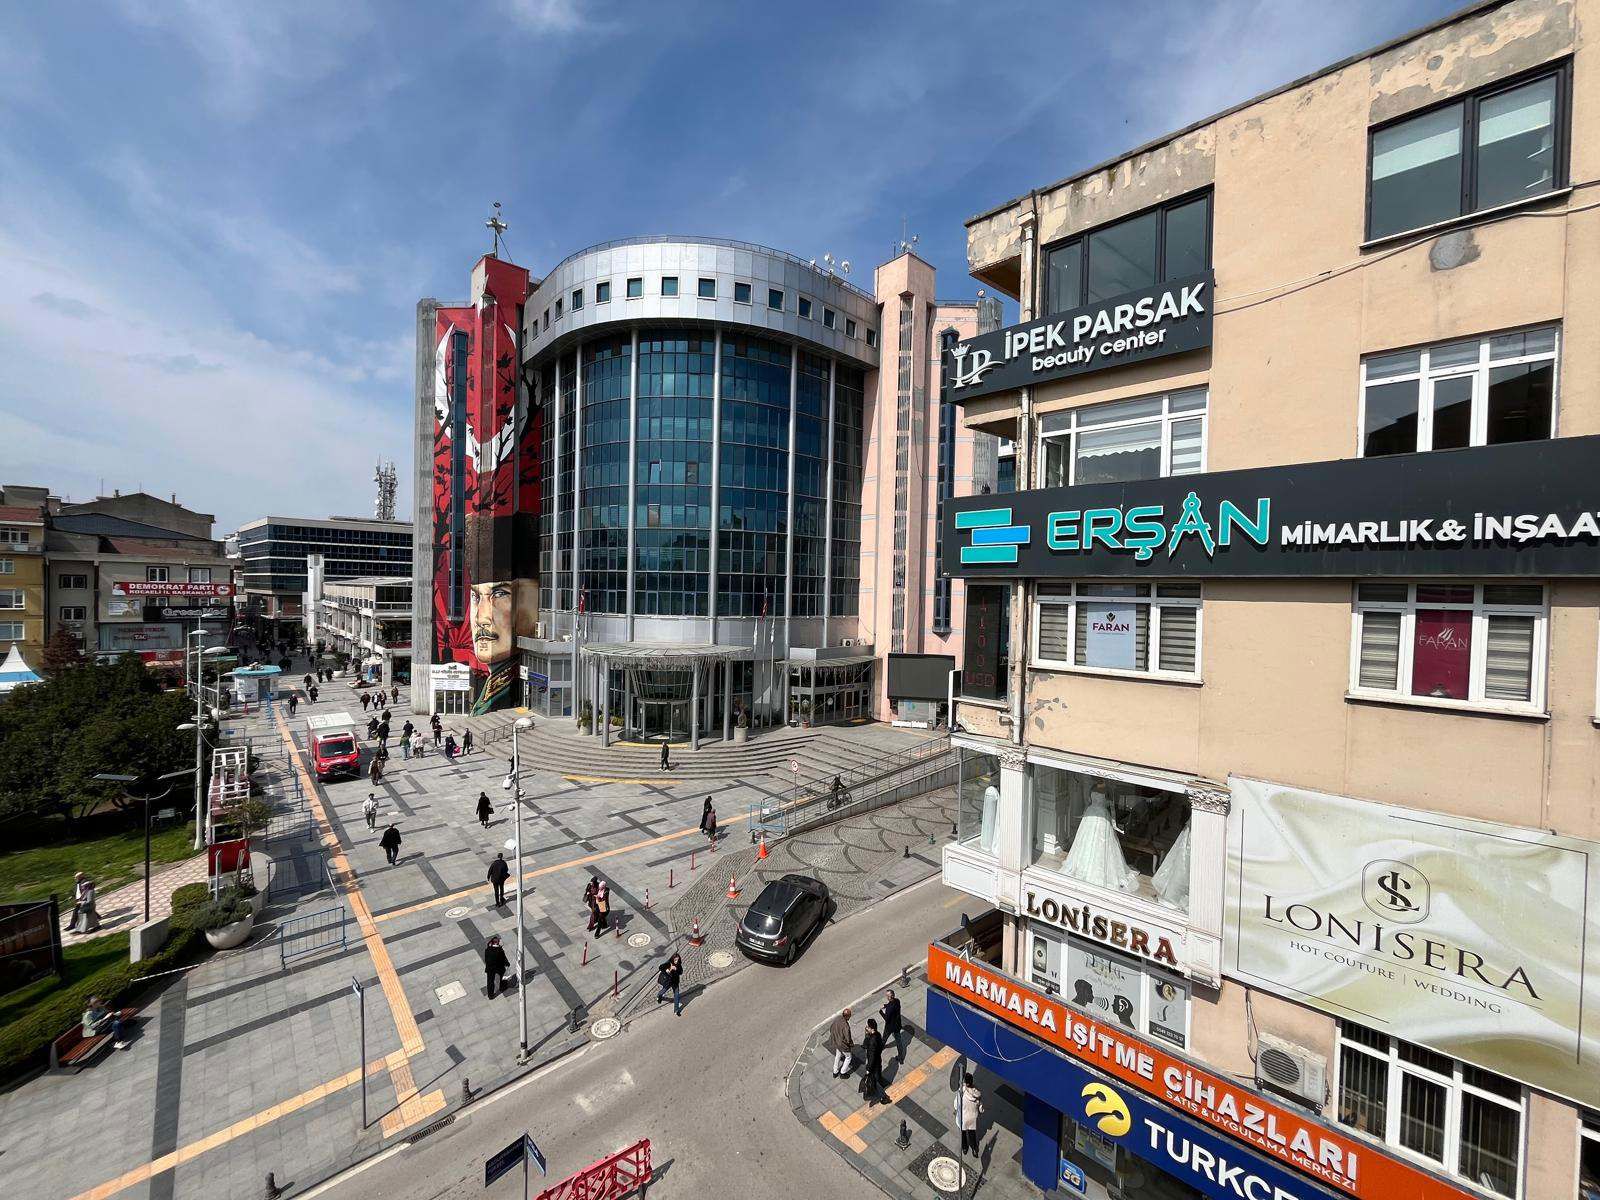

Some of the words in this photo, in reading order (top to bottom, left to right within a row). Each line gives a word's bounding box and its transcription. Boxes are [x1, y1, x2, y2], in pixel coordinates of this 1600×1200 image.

[1004, 320, 1067, 360] İPEK
[1073, 282, 1208, 343] PARSAK
[1032, 343, 1097, 372] beauty
[1099, 327, 1167, 356] center
[1046, 492, 1271, 561] ERŞAN
[1280, 519, 1434, 546] MİMARLIK
[1473, 511, 1600, 543] İNŞAA
[128, 583, 185, 591] DEMOKRAT
[1092, 622, 1130, 632] FARAN
[1418, 633, 1468, 651] FARAN
[1025, 891, 1180, 968] LONİSERA
[1263, 894, 1546, 1001] LONİSERA
[1289, 940, 1321, 957] HOT
[1323, 951, 1397, 981] COUTURE
[1413, 978, 1503, 1015] WEDDING
[944, 961, 1058, 1033] MARMARA
[1064, 1010, 1155, 1082] İŞİTME
[1162, 1065, 1359, 1182] CİHAZLARI
[1165, 1090, 1198, 1113] SATIŞ
[1201, 1108, 1210, 1119] &
[1211, 1112, 1289, 1158] UYGULAMA
[1063, 1167, 1081, 1186] 5G
